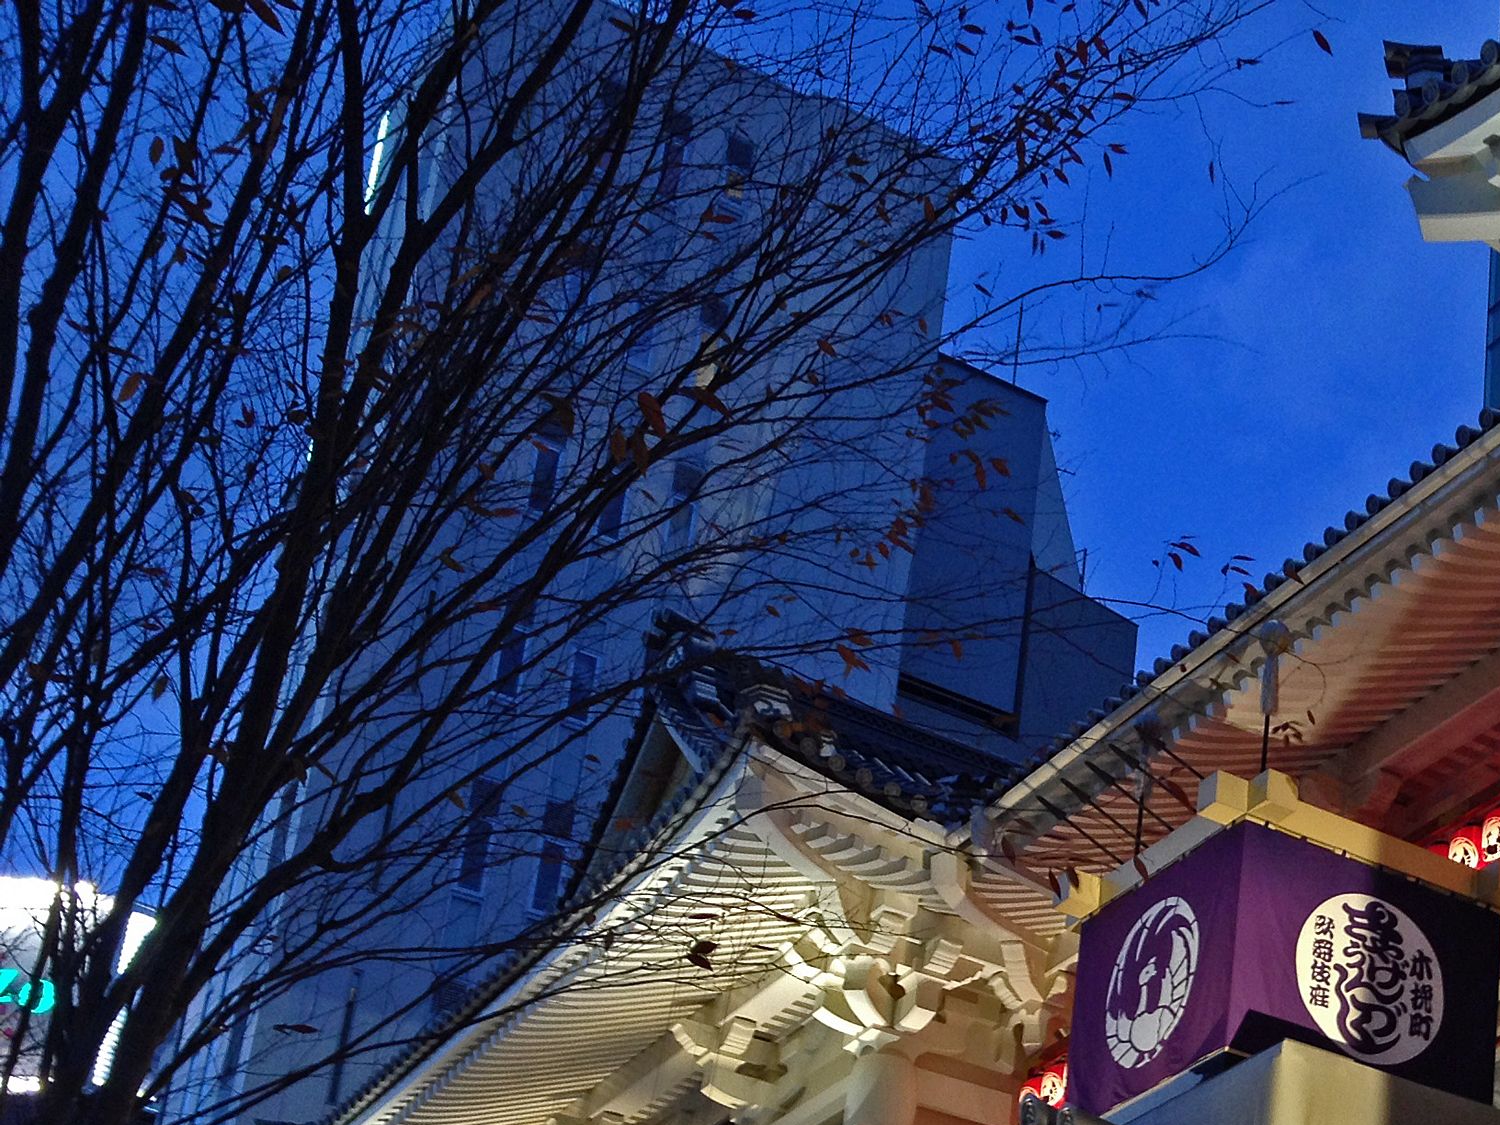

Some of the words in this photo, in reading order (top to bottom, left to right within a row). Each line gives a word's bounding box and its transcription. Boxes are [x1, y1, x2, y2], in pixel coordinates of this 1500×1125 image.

[1309, 915, 1335, 1008] 歌舞伎座
[1409, 949, 1433, 1041] 木挽町
